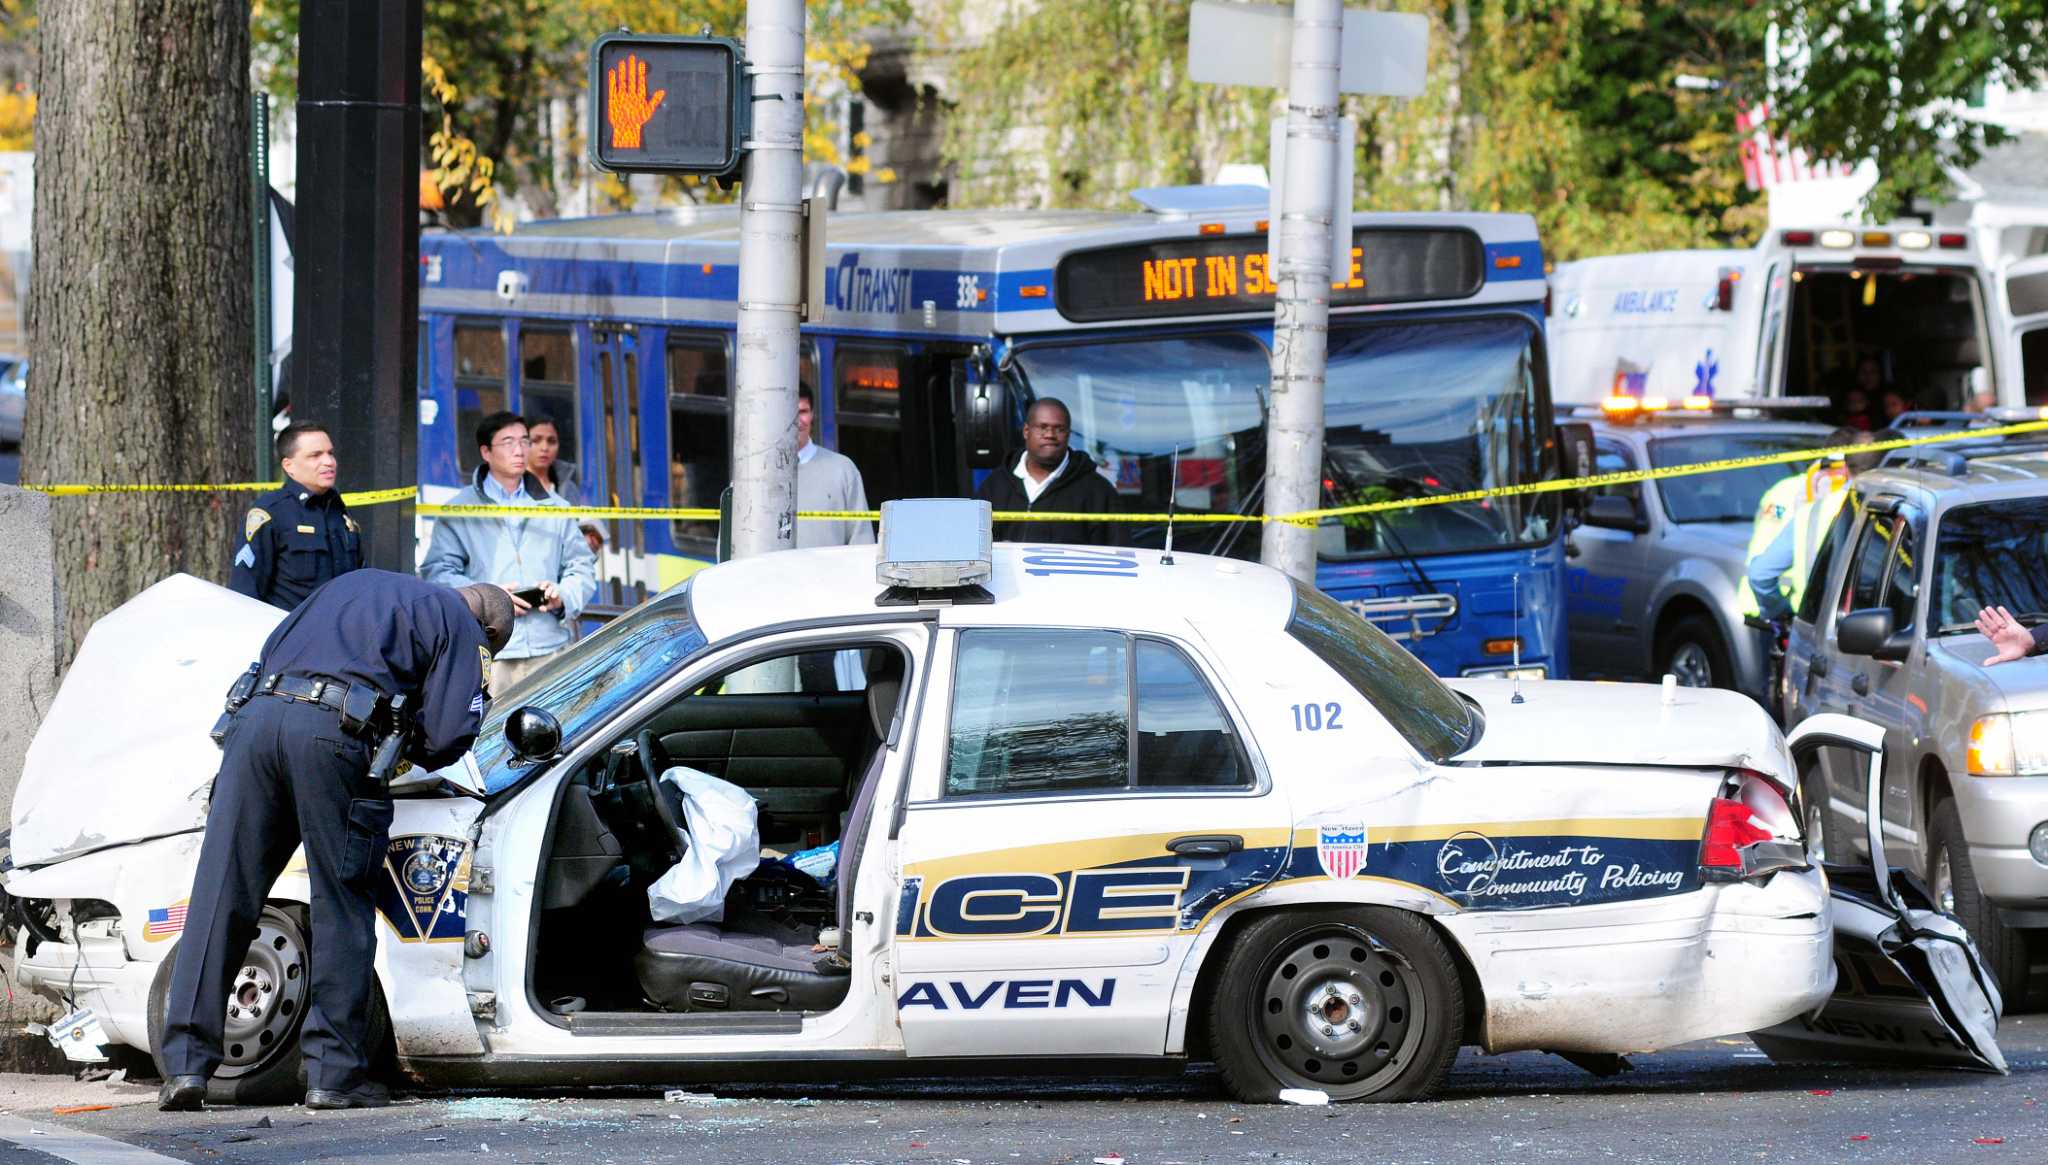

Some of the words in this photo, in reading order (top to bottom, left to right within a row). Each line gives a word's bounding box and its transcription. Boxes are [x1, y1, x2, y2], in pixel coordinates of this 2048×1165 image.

[857, 267, 911, 314] TRANSIT
[957, 275, 979, 308] 336
[1143, 258, 1197, 301] NOT
[1204, 255, 1237, 297] IN
[1613, 288, 1679, 313] AMBULANCE
[1291, 702, 1343, 731] 102
[387, 839, 416, 853] NEW
[1440, 846, 1573, 875] Commitment
[1581, 845, 1604, 866] to
[1466, 871, 1588, 897] Community
[1600, 864, 1684, 889] Policing
[414, 896, 434, 905] POLICE
[1799, 1014, 1905, 1043] NEW
